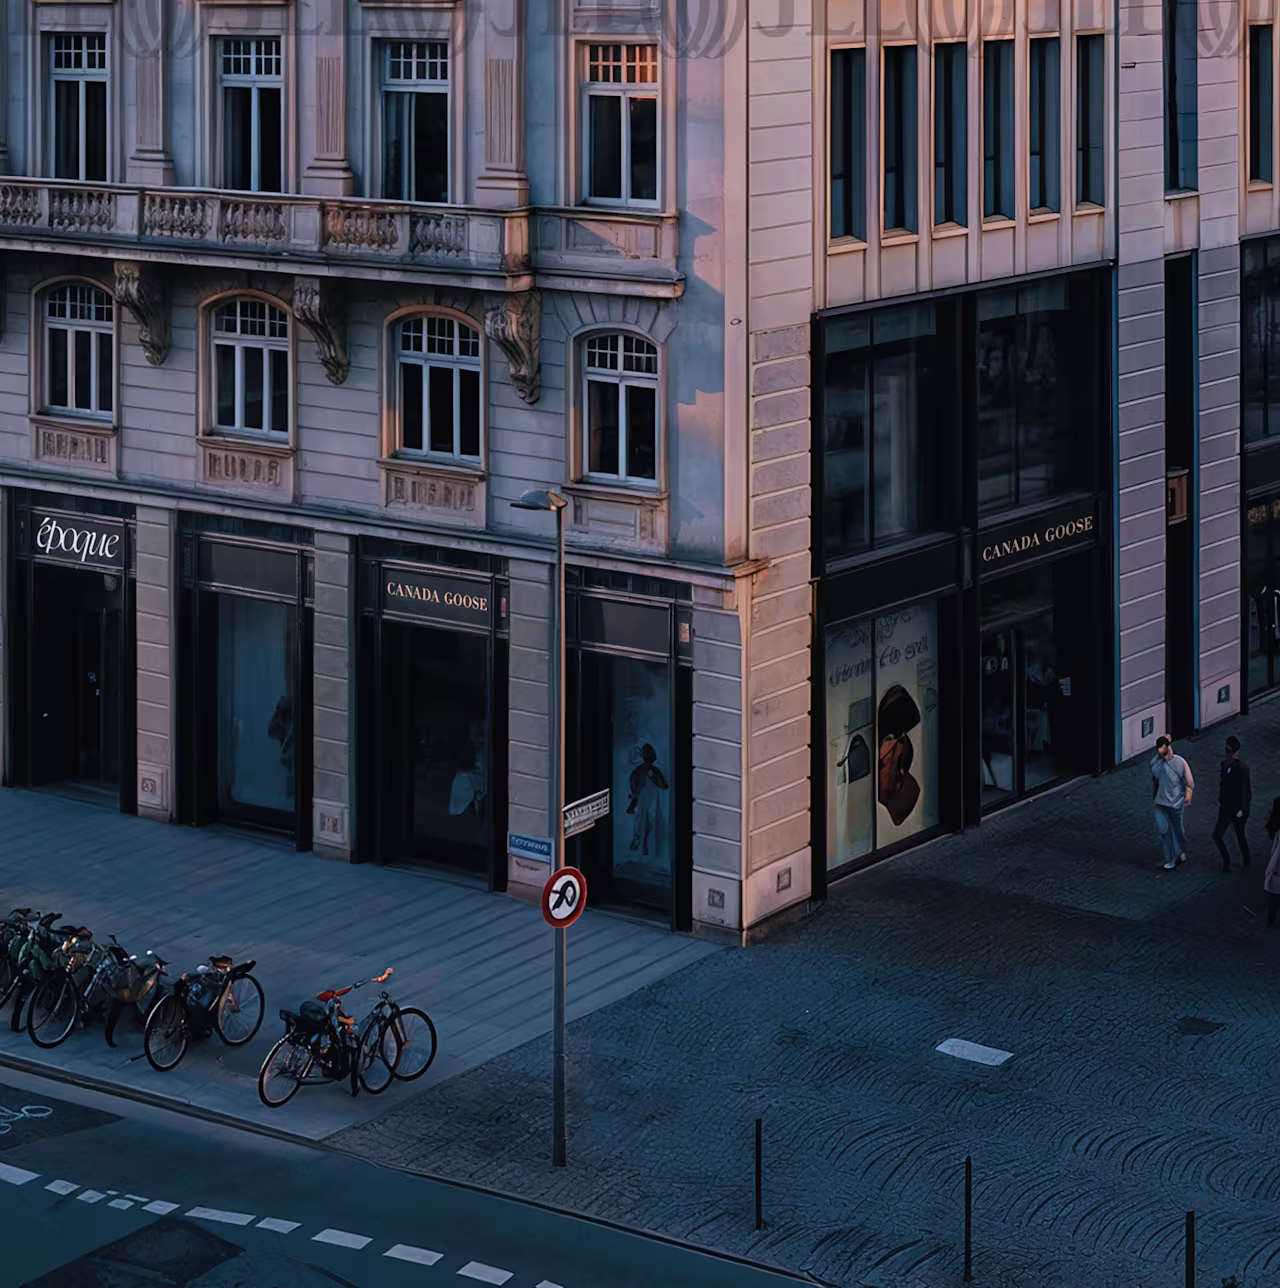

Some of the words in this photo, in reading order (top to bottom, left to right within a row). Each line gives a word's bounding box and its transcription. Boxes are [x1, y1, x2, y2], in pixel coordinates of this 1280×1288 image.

[37, 517, 119, 562] époque
[982, 532, 1040, 561] CANADA
[1045, 516, 1093, 542] GOOSE
[387, 582, 440, 603] CANADA
[444, 592, 488, 611] GOOSE
